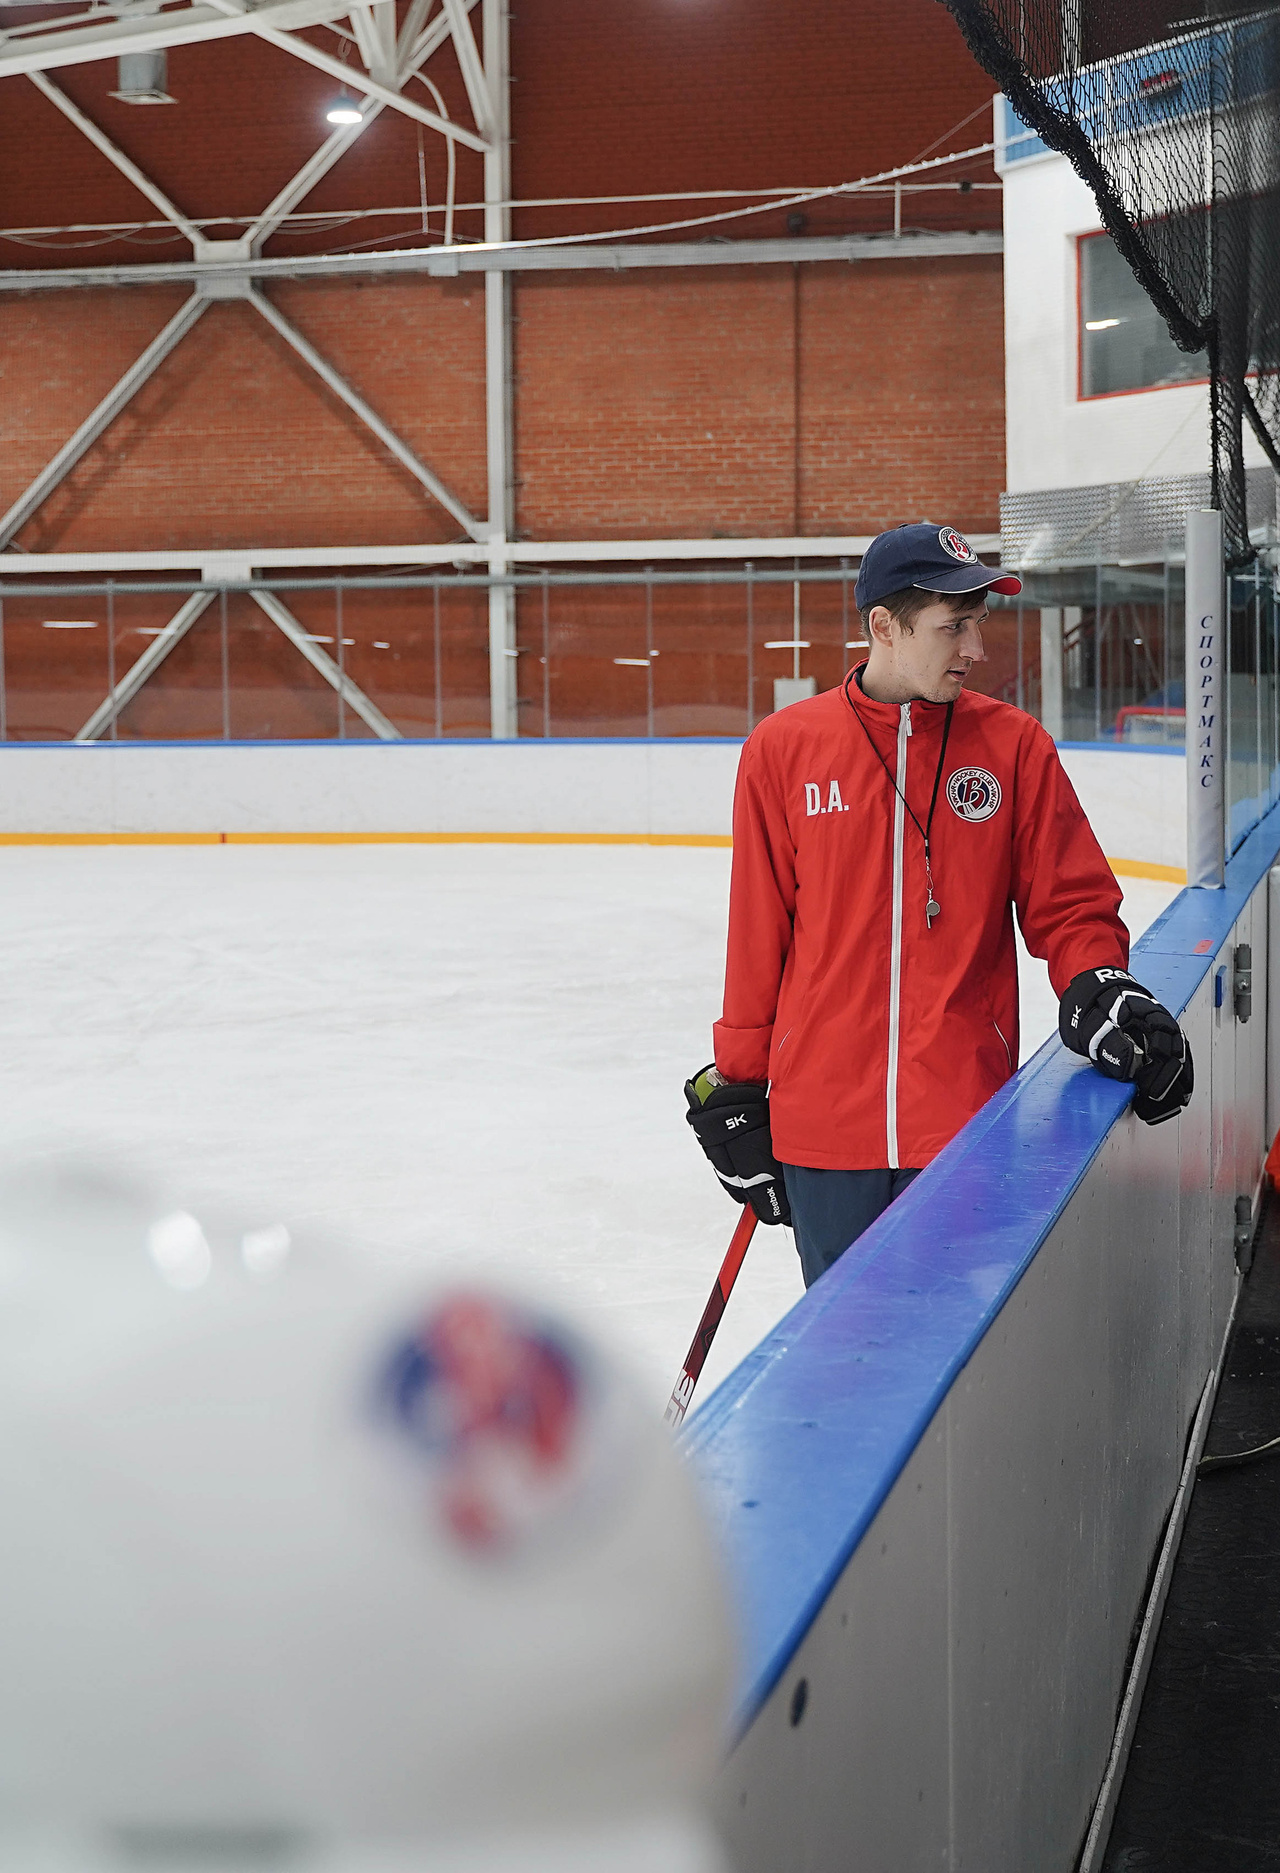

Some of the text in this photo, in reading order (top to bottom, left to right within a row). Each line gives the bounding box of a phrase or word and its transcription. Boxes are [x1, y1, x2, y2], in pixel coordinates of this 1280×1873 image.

[1199, 615, 1215, 788] СПОРТМАКС
[954, 770, 994, 787] HOCKEY CLUB
[805, 780, 849, 816] D.A.
[1101, 1048, 1121, 1067] Reebok
[766, 1186, 782, 1217] Reebok
